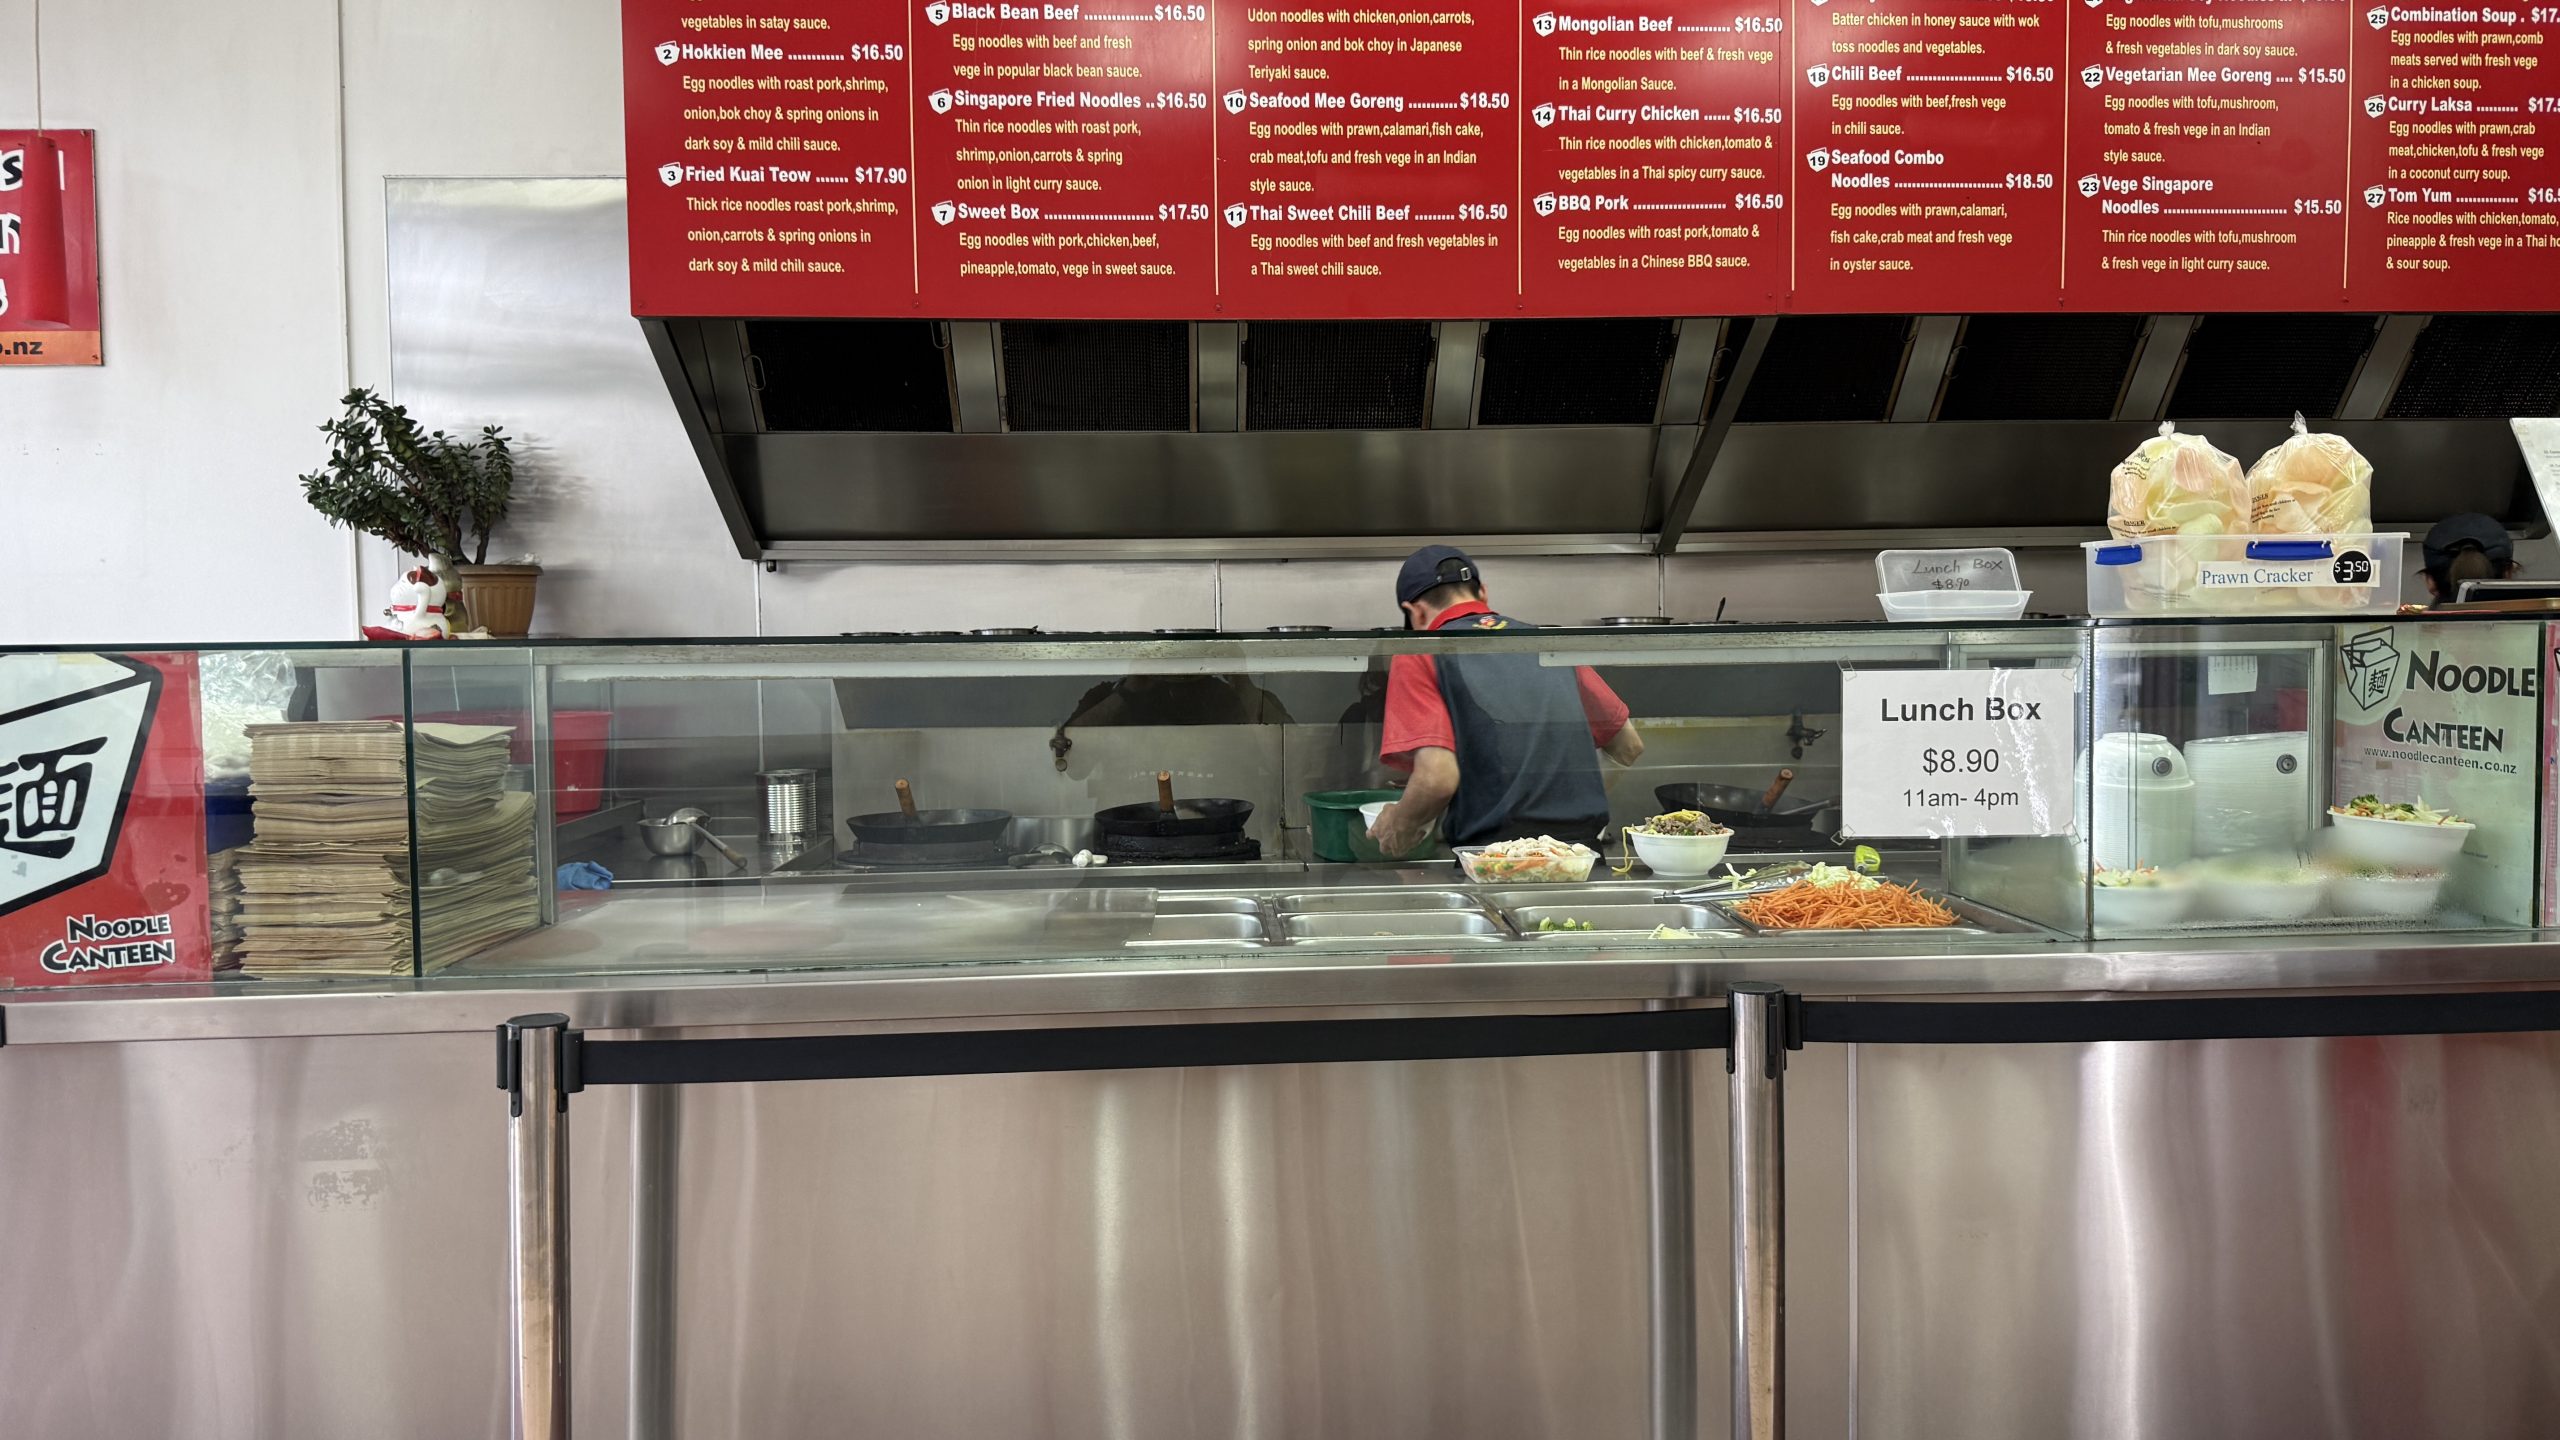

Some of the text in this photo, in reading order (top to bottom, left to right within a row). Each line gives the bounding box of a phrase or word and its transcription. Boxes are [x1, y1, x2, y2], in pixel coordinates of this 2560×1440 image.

[935, 3, 1205, 21] 5 Black Bean Beef $16.50
[2371, 14, 2386, 24] 25
[2391, 7, 2477, 22] Combination
[2482, 8, 2516, 26] Soup
[681, 15, 830, 32] vegetables in satay sauce.
[1536, 16, 1782, 35] 13 Mongolian Beef $16.50
[2107, 14, 2283, 30] Egg noodles with tofu,mushrooms
[664, 44, 903, 61] 2 Hokkien Mee $16.50
[1833, 40, 1985, 56] toss noodles and vegetables.
[1249, 65, 1329, 81] Teriyaki sauce.
[1810, 66, 2053, 83] 18 Chili Beef $16.50
[2084, 67, 2345, 86] 22 Vegetarian Mee Goreng $15.50
[683, 76, 888, 93] Egg noodles with roast pork,shrimp,
[937, 90, 1206, 110] 6 Singapore Fried Noodles $16.50
[1227, 92, 1509, 112] 10 Seafood Mee Goreng $18.50
[2368, 103, 2383, 112] 26
[2389, 97, 2427, 114] Curry
[2432, 97, 2472, 111] Laksa
[1535, 106, 1781, 124] 14 Thai Curry Chicken $16.50
[956, 148, 1122, 165] shrimp,onion,carrots & spring
[1810, 149, 1944, 166] 19 Seafood Combo
[2389, 144, 2544, 160] meat,chicken,tofu & fresh vege
[668, 166, 906, 184] 3 Fried Kuai Teow $17.90
[1832, 173, 2053, 189] Noodles $18.50
[1250, 178, 1314, 194] style sauce.
[2082, 176, 2213, 194] 23 Vege Singapore
[1536, 193, 1783, 211] 15 BBQ Pork $16.50
[2368, 194, 2383, 203] 27
[2388, 188, 2417, 202] Tom
[2422, 188, 2451, 202] Yum
[939, 203, 1208, 221] 7 Sweet Box $17.50
[1227, 204, 1507, 221] 11 Thai Sweet Chili Beef $16.50
[2102, 199, 2341, 215] Noodles $15.50
[688, 228, 871, 245] onion,carrots & spring onions in
[960, 233, 1159, 249] Egg noodles with pork,chicken,beef,
[961, 261, 1175, 278] pineapple,tomato, vege in sweet sauce.
[1558, 254, 1749, 272] vegetables in a Chinese BBQ sauce.
[1830, 258, 1913, 273] in oyster sauce.
[2386, 257, 2450, 272] & sour soup.
[1912, 558, 2003, 574] Lunch Box
[1931, 578, 1970, 591] $8.90
[2202, 569, 2249, 585] Prawn
[2254, 567, 2313, 584] Cracker
[2406, 650, 2536, 698] NOODLE
[1881, 697, 2042, 722] Lunch Box
[2383, 707, 2503, 753] CANTEEN
[1922, 747, 1999, 776] $8.90
[2364, 747, 2517, 775] www.noodlecanteen.co.nz
[1904, 788, 2019, 810] 11am- 4pm
[68, 915, 169, 941] NOODLE
[41, 941, 174, 972] CANTEEN
